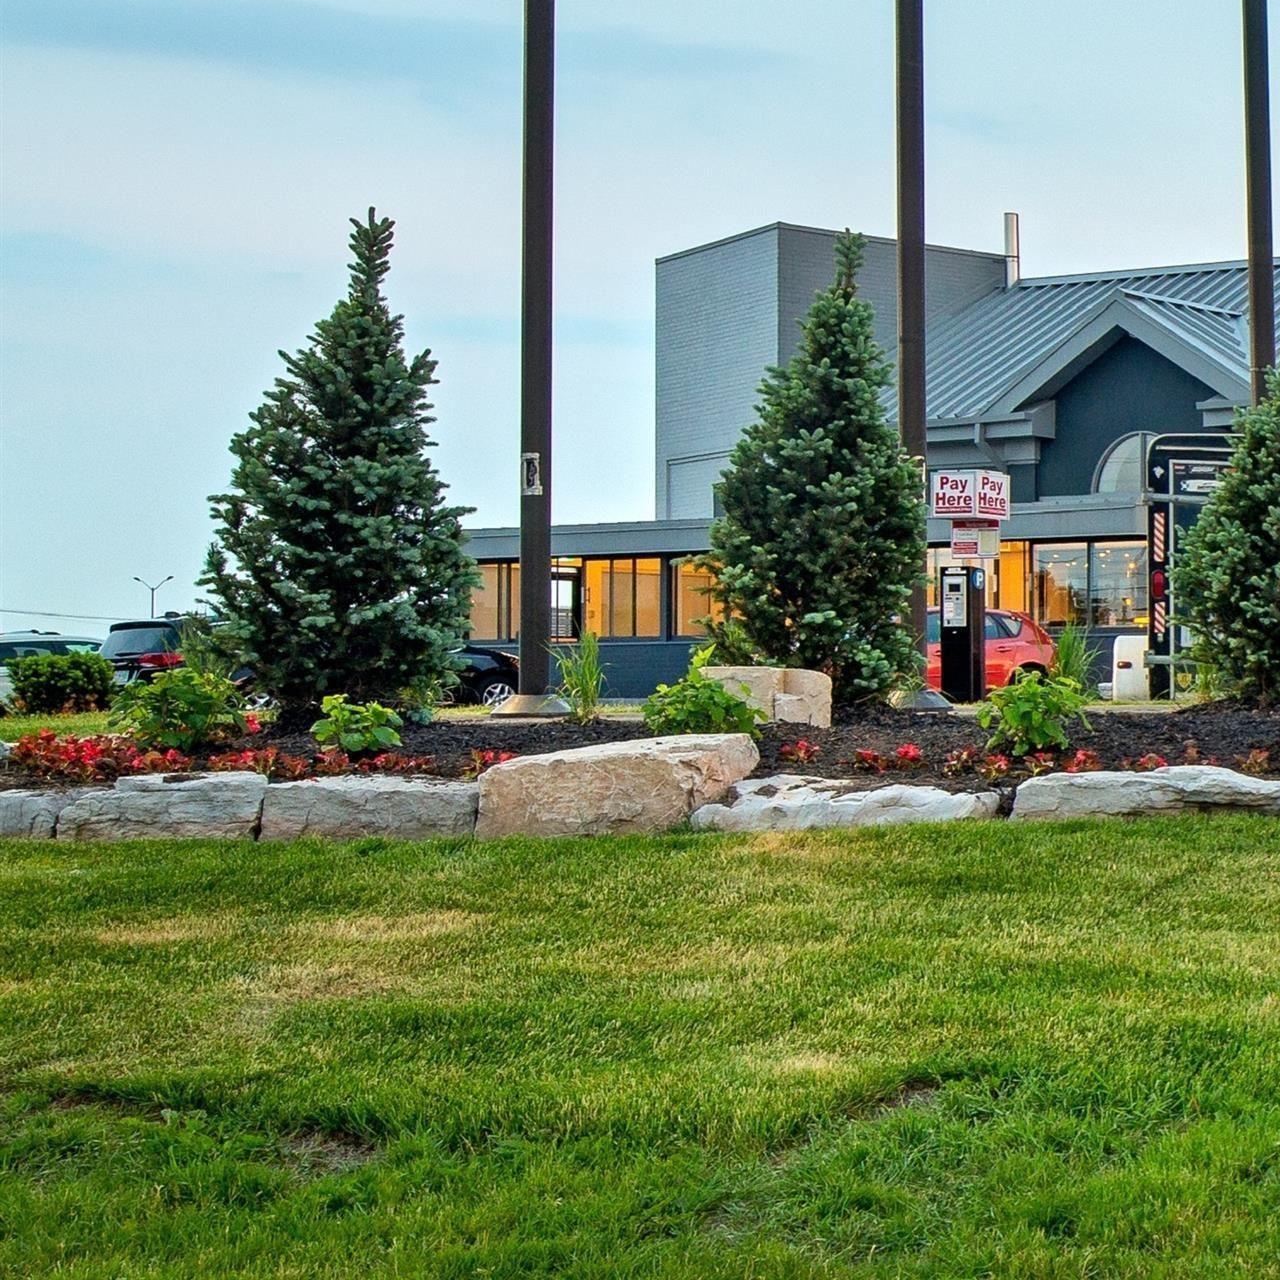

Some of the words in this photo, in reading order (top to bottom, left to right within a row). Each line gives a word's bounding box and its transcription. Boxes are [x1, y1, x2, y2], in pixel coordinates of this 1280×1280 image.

[940, 477, 968, 493] Pay
[982, 477, 1003, 495] Pay
[935, 492, 972, 506] Here
[978, 492, 1006, 508] Here
